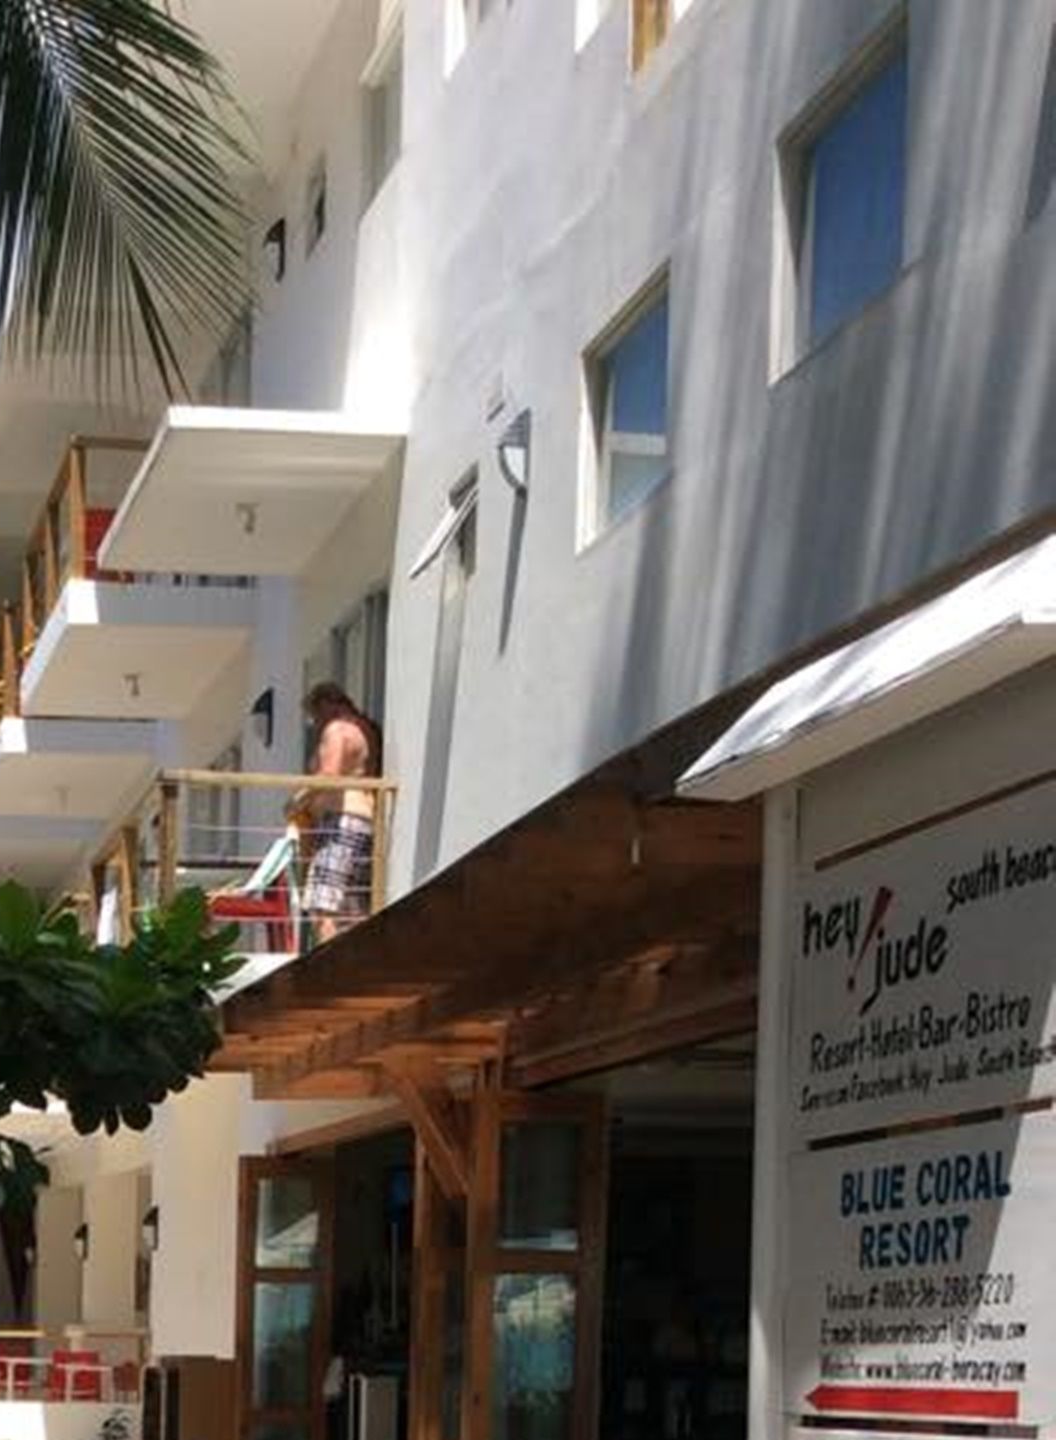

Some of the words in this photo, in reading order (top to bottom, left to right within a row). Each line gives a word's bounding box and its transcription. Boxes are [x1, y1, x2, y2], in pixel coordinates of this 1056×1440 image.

[947, 848, 1000, 915] south
[1005, 845, 1056, 889] beac
[859, 916, 949, 1018] jude
[840, 1164, 905, 1218] BLUE
[916, 1151, 1011, 1206] CORAL
[859, 1215, 970, 1271] RESORT
